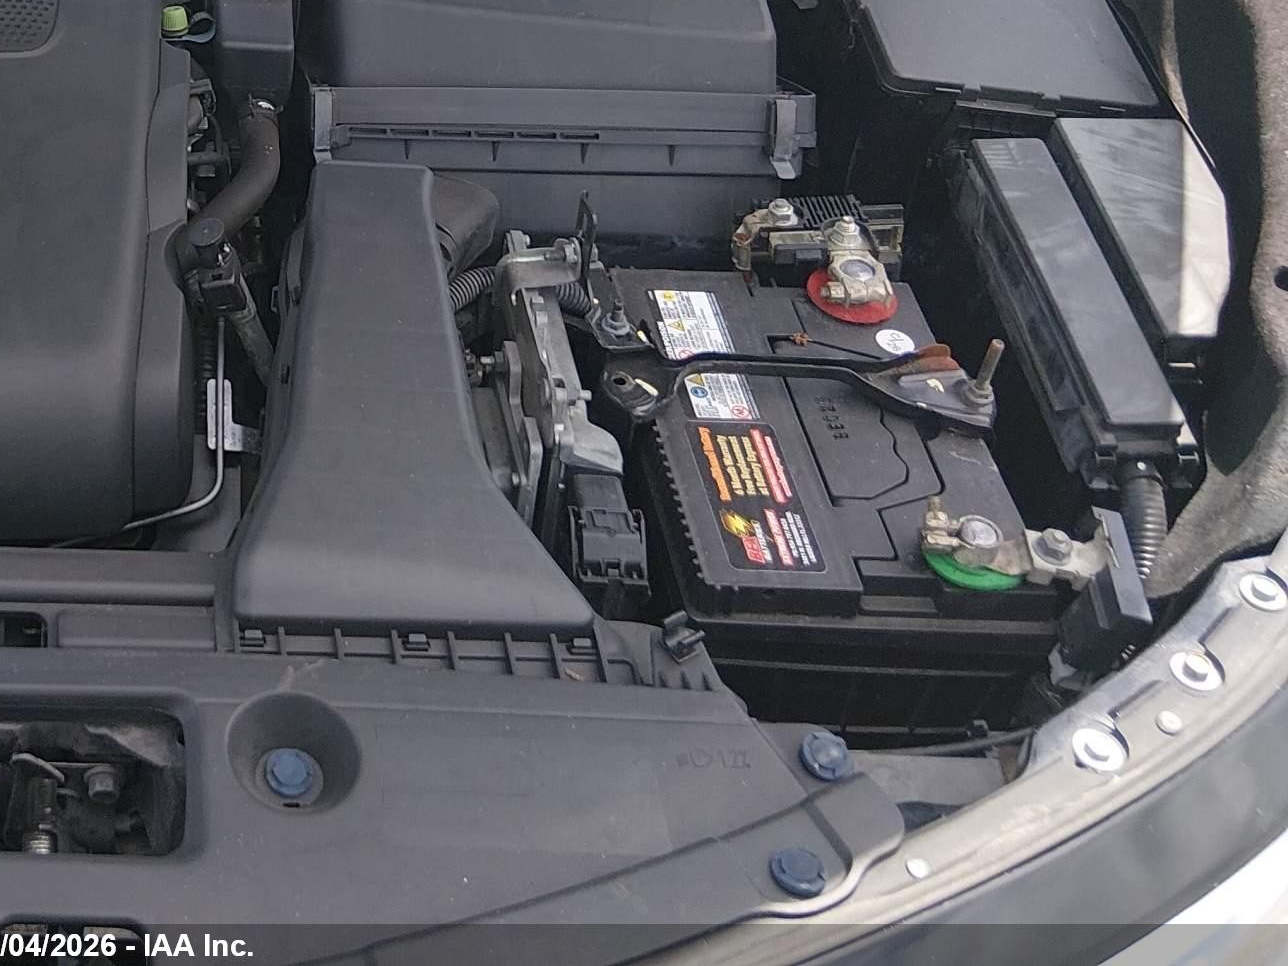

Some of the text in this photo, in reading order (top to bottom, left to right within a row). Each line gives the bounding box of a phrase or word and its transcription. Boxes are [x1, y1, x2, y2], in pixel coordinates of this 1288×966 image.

[716, 435, 734, 465] Warranty
[740, 436, 758, 462] Express
[726, 465, 742, 487] Month
[728, 435, 757, 495] Free Replacement
[750, 462, 768, 487] Battery
